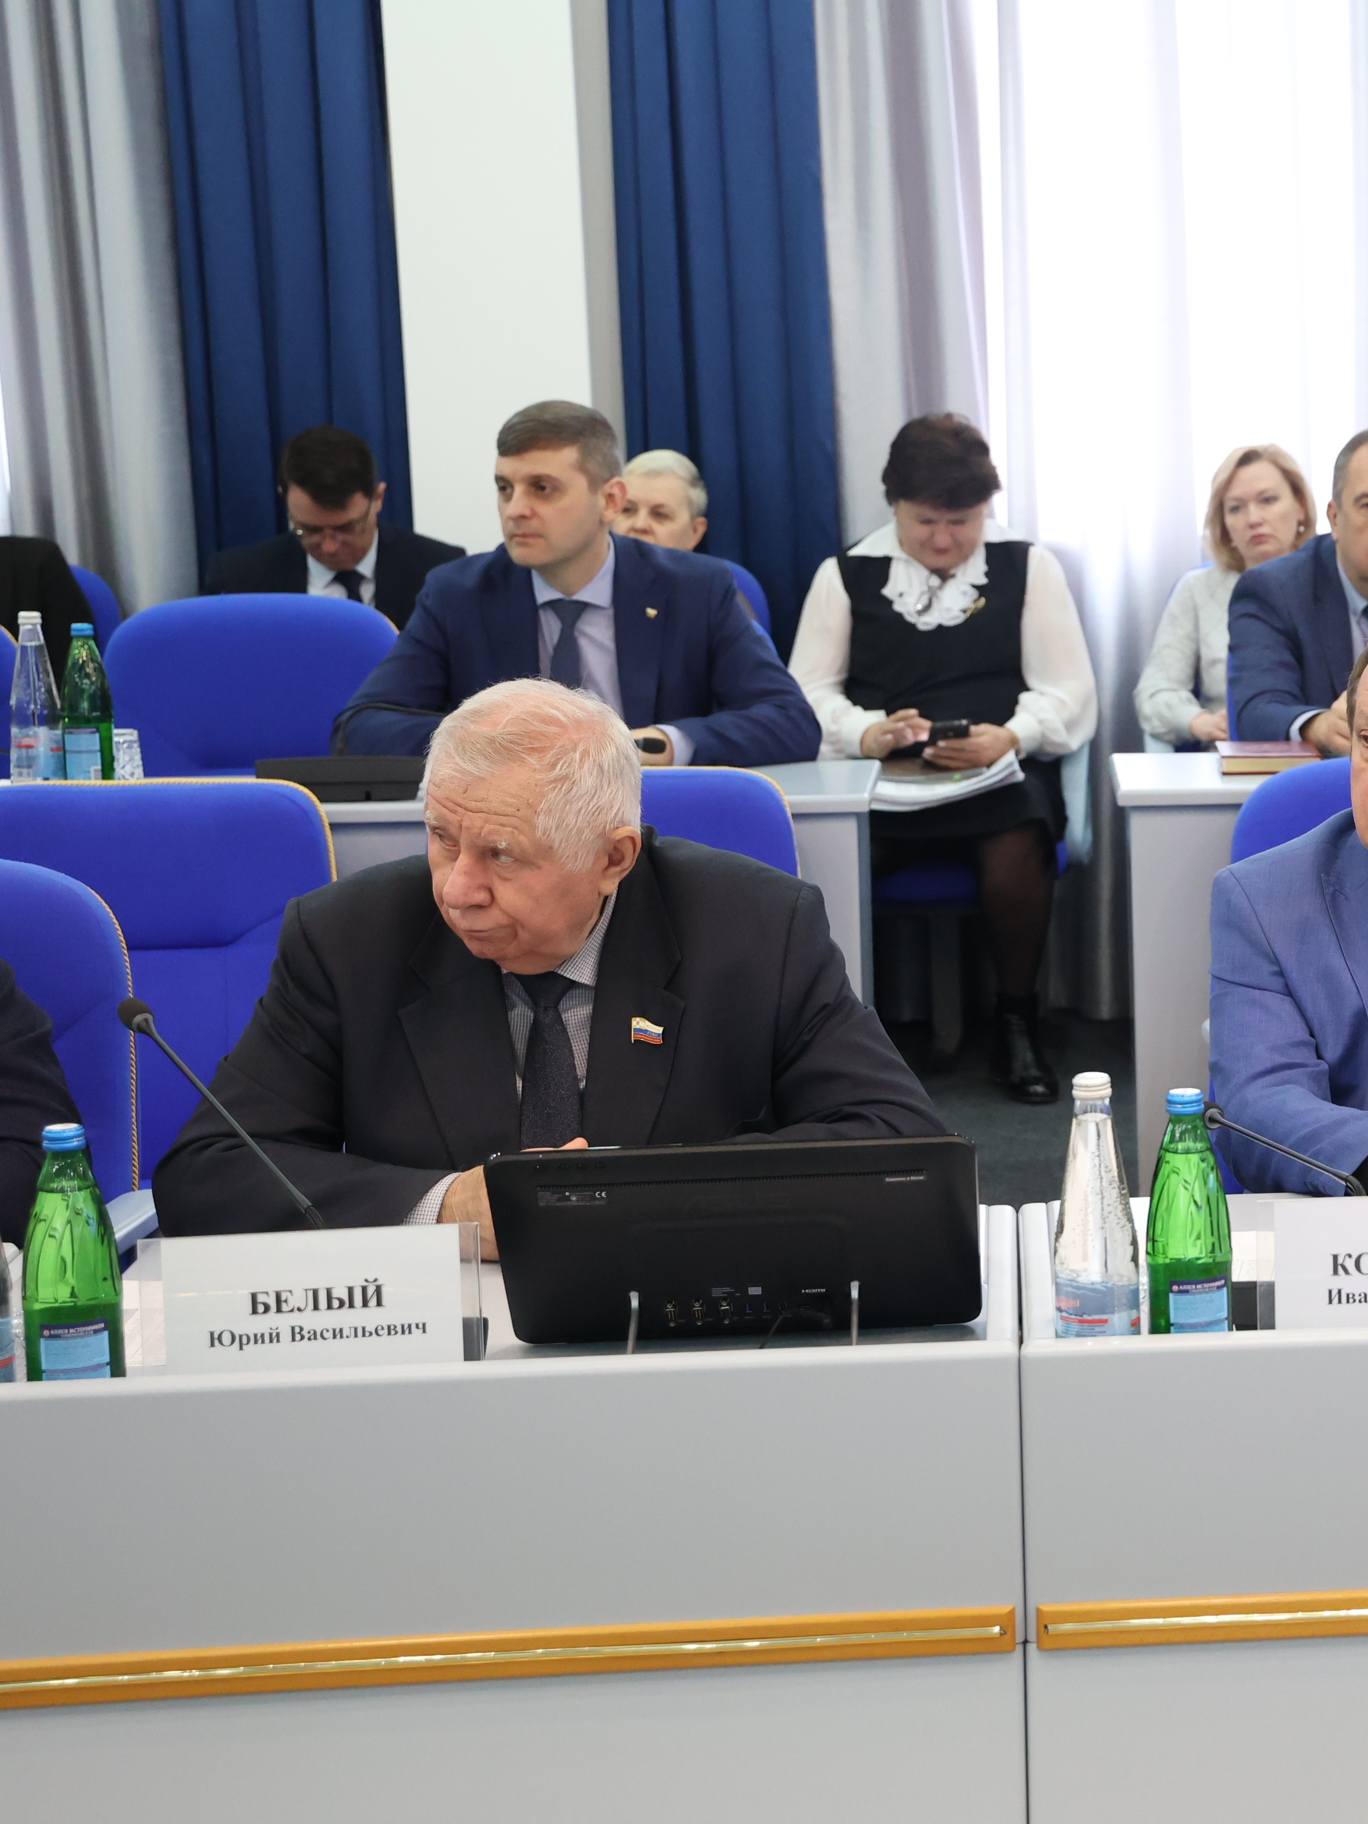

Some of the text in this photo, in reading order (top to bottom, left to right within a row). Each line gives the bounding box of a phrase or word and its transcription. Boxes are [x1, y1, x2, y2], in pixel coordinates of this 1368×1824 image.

[249, 1277, 386, 1316] БЕЛЫЙ
[208, 1321, 428, 1351] Юрий Васильевич
